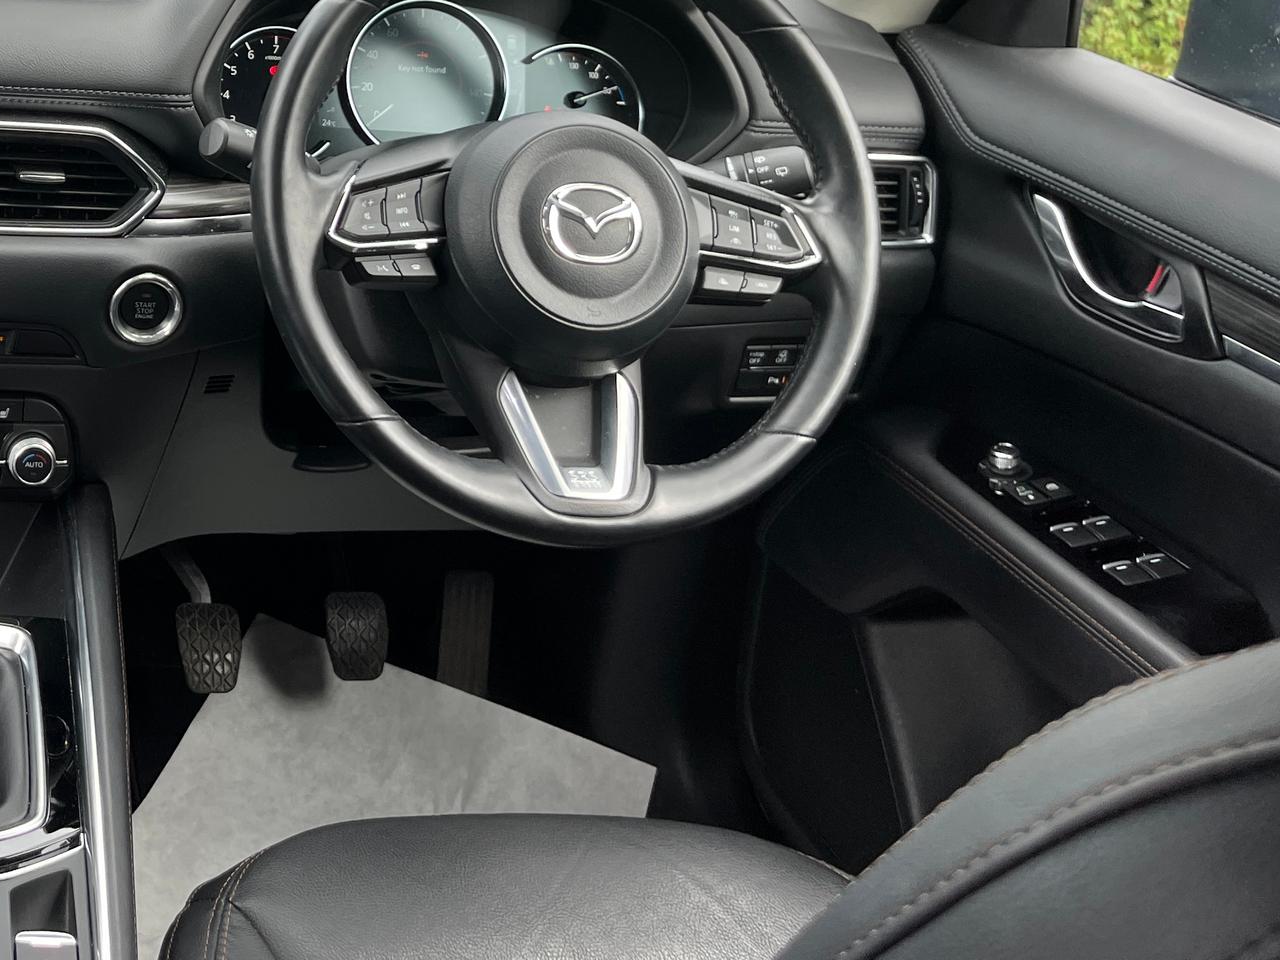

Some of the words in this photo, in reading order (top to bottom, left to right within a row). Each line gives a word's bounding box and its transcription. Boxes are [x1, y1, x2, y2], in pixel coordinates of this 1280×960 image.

[273, 45, 279, 54] 7
[247, 50, 255, 60] 6
[366, 50, 378, 59] 40
[230, 66, 238, 76] 5
[398, 64, 410, 74] Key
[425, 64, 447, 75] found
[361, 82, 373, 91] 20
[222, 90, 230, 99] 4
[24, 461, 44, 469] AUTO
